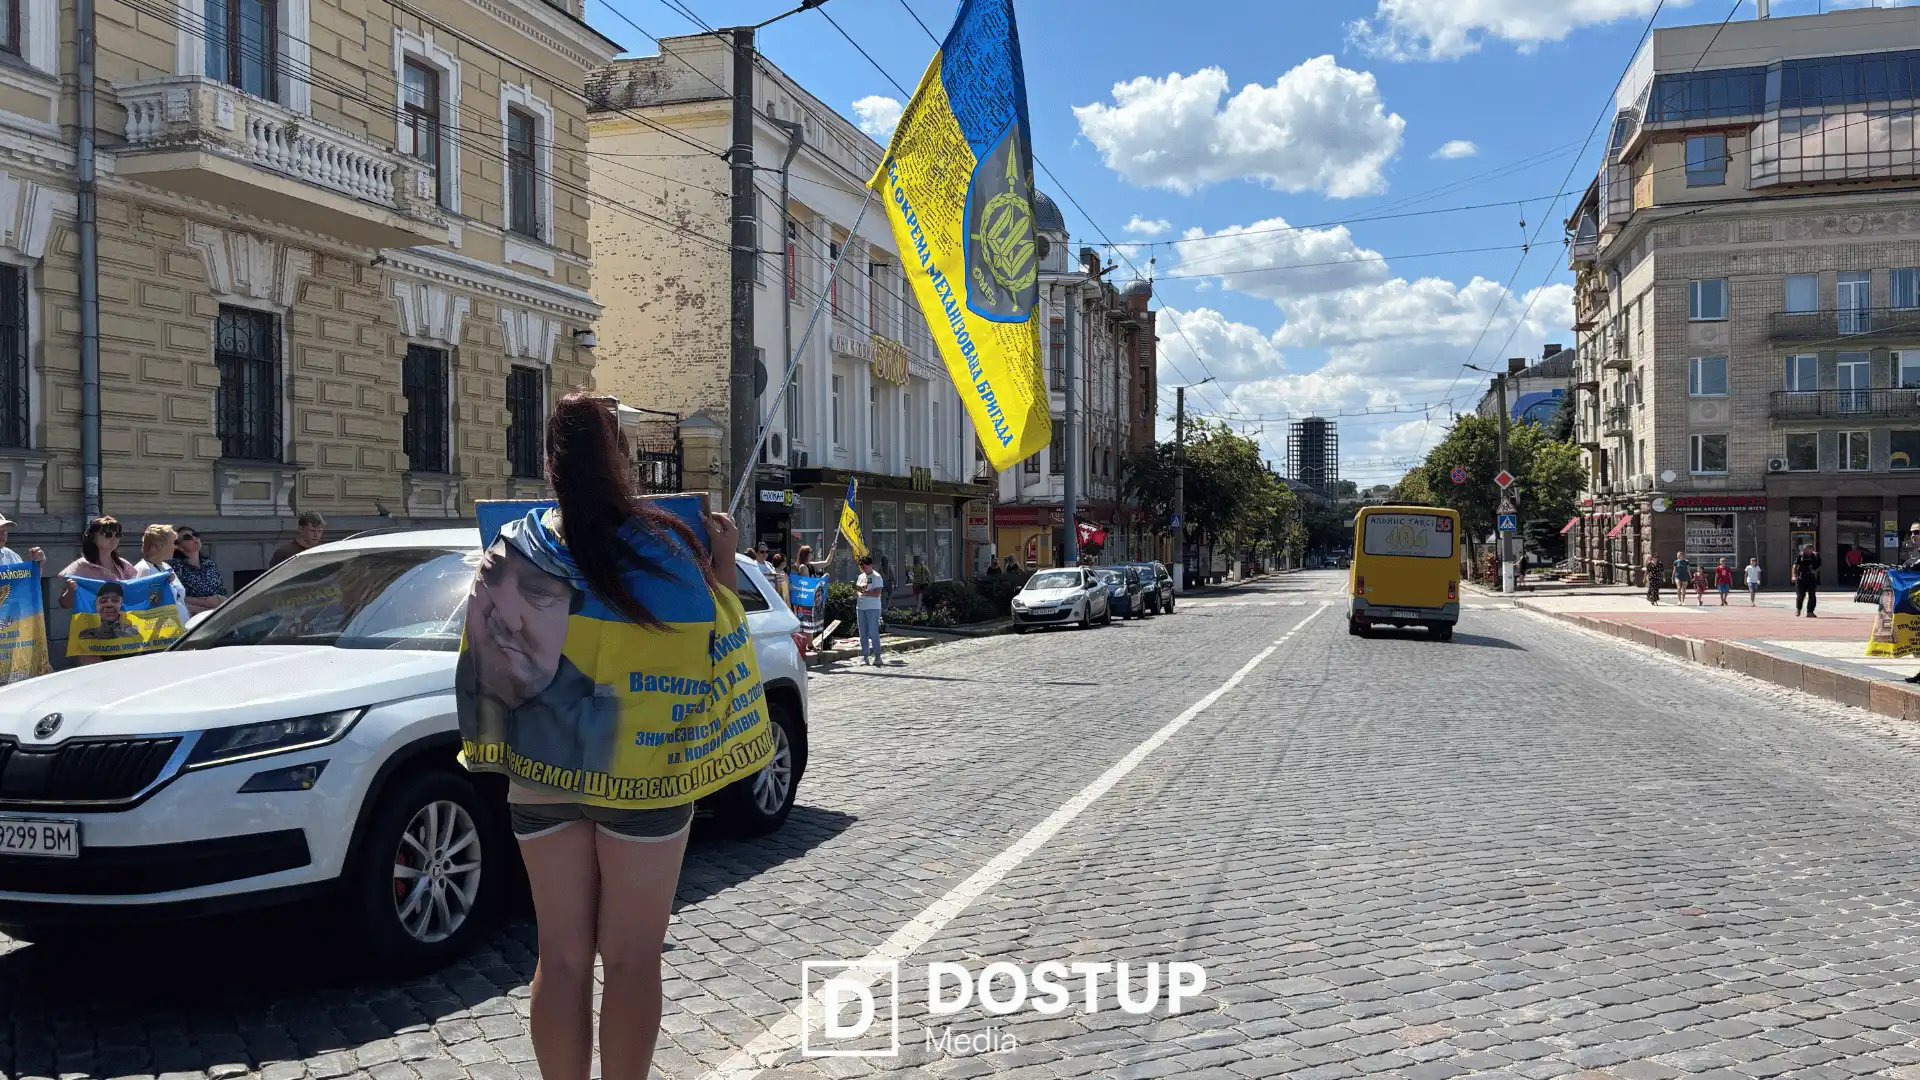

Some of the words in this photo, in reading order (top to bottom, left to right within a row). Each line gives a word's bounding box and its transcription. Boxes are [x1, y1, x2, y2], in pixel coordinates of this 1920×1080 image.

[894, 186, 931, 267] ОКРЕМА
[926, 262, 983, 382] МЕХАНІЗОВАНА
[976, 378, 1015, 449] БРИГАДА
[1370, 517, 1405, 525] АЛЬЯНС
[1408, 518, 1435, 527] ТАКСІ
[584, 767, 700, 800] Шукаємо!
[43, 826, 71, 852] BM
